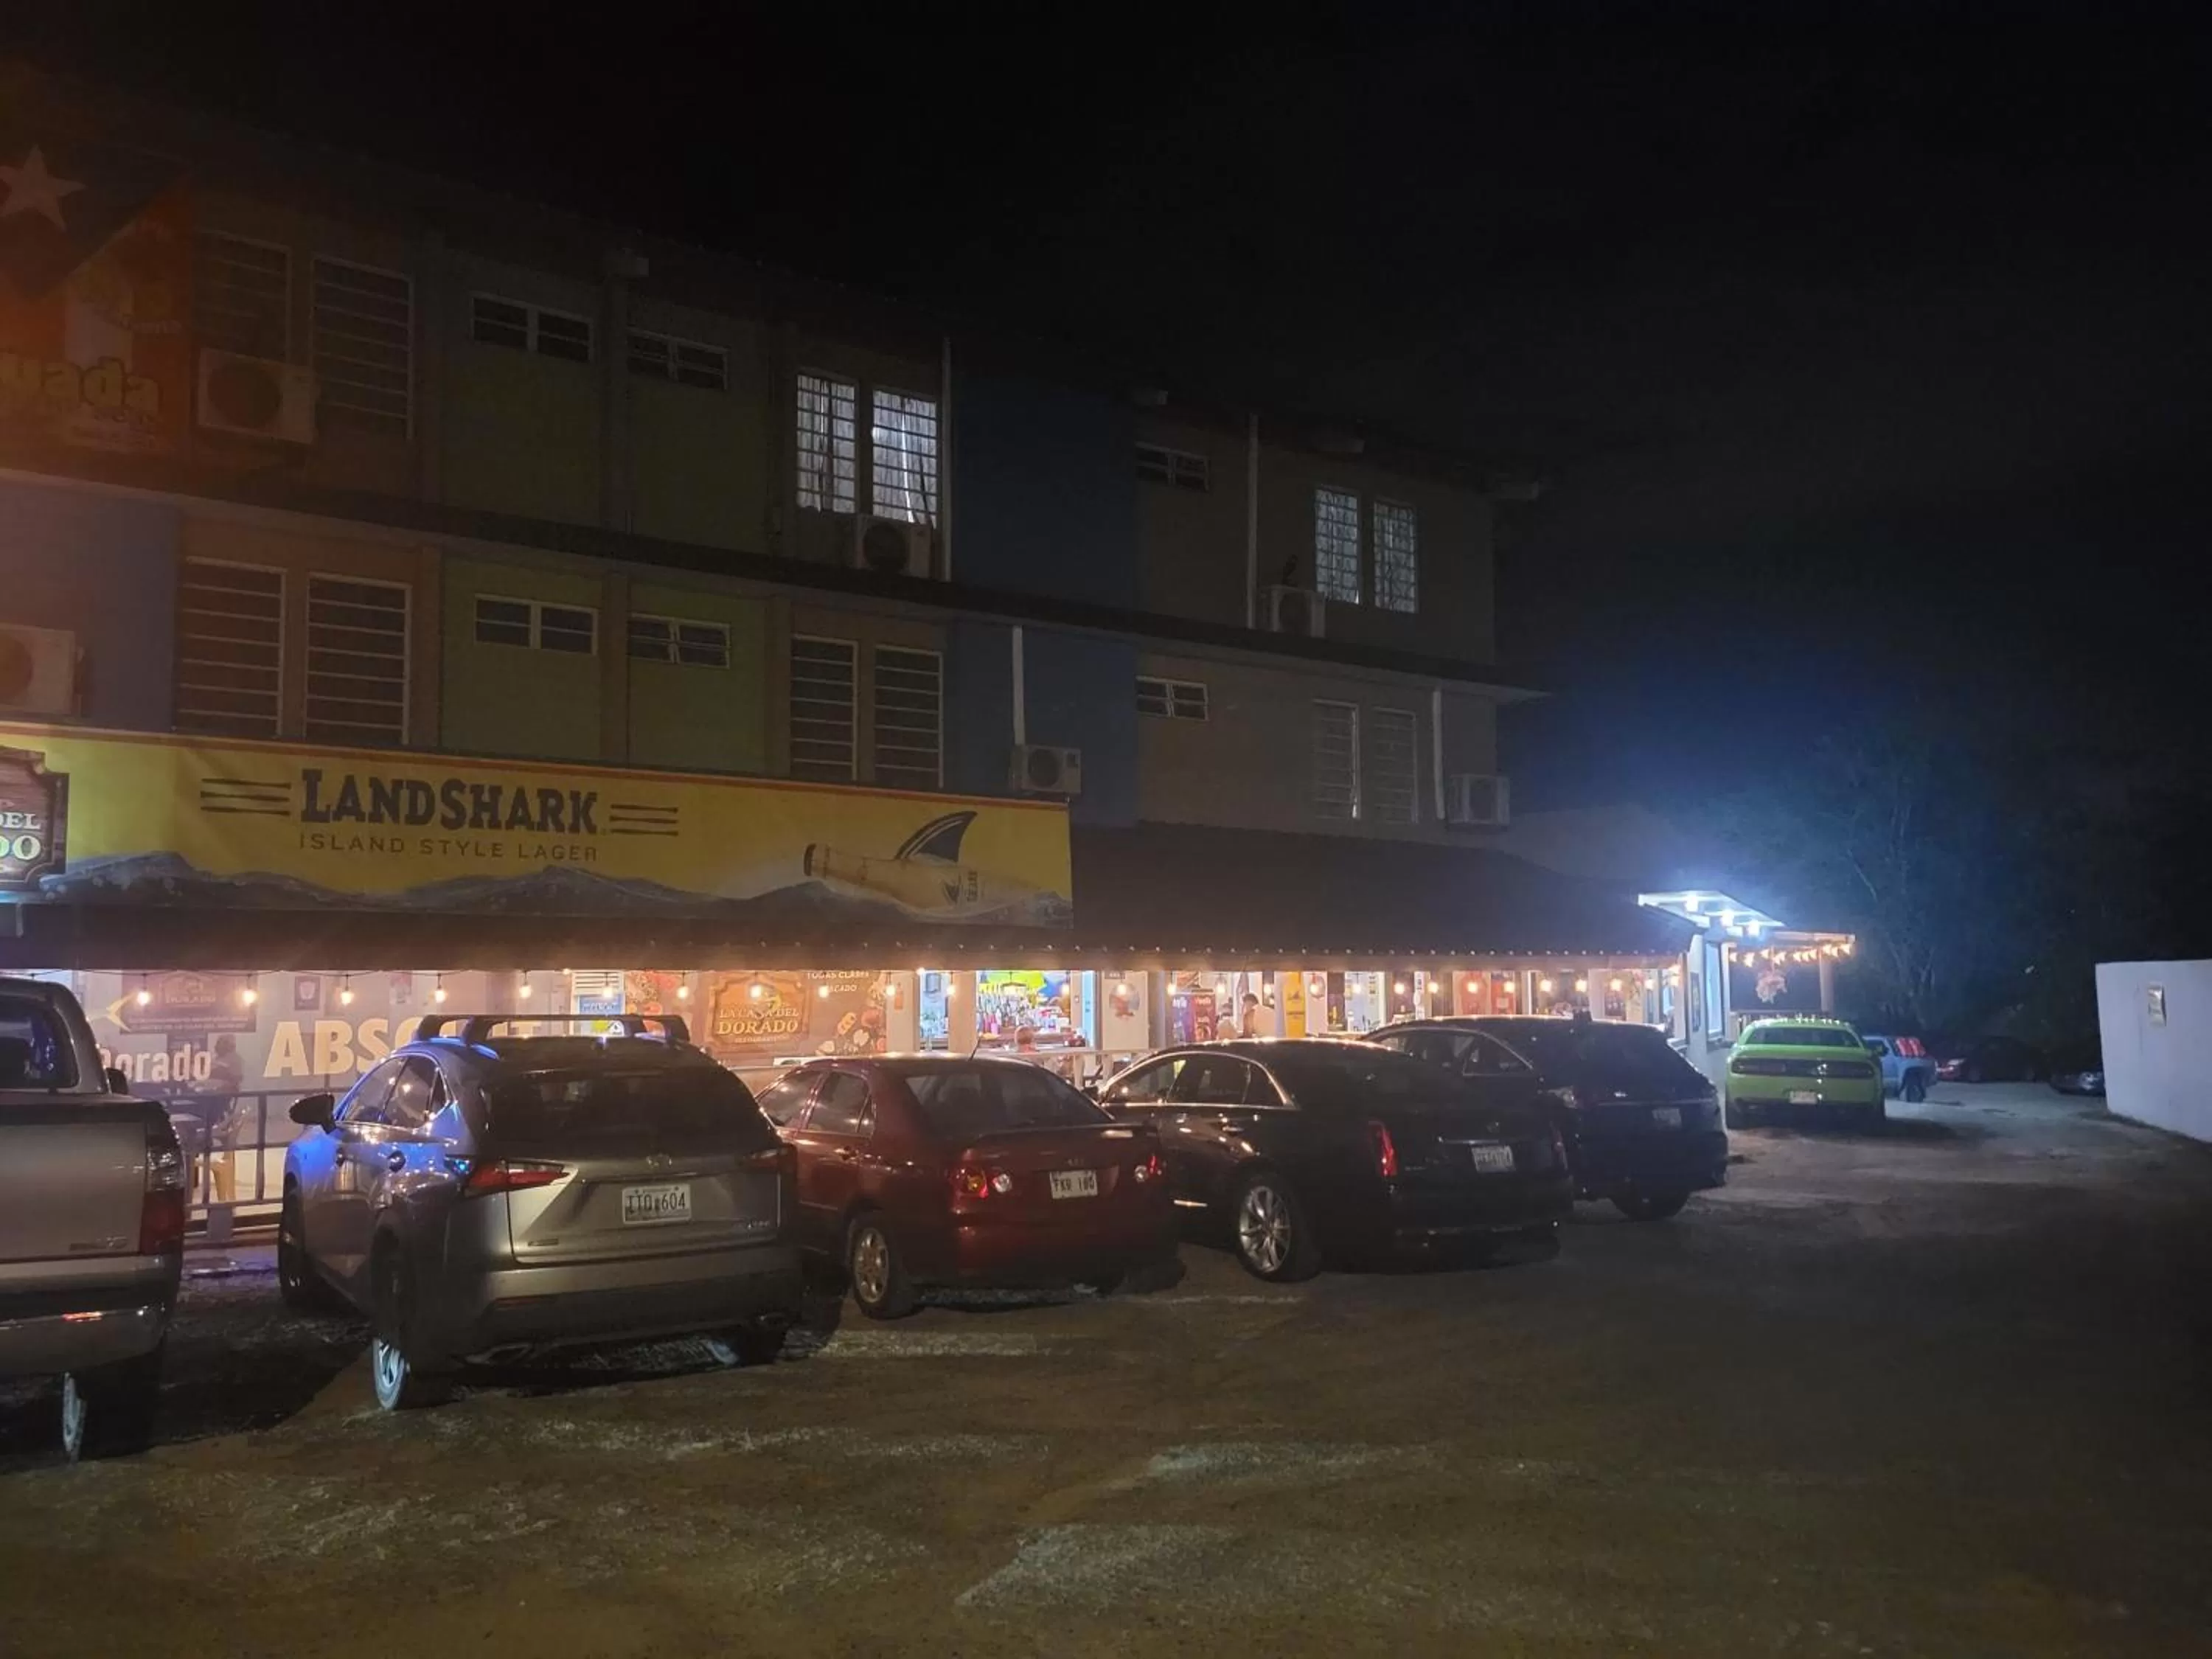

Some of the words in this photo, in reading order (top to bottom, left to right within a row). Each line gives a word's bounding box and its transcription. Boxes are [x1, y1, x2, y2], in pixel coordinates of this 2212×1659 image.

[301, 769, 598, 835] LANDSHARK
[0, 813, 40, 830] EL
[300, 832, 405, 853] ISLAND
[420, 838, 504, 858] STYLE
[518, 845, 597, 862] LAGER
[716, 1019, 799, 1035] DORADO
